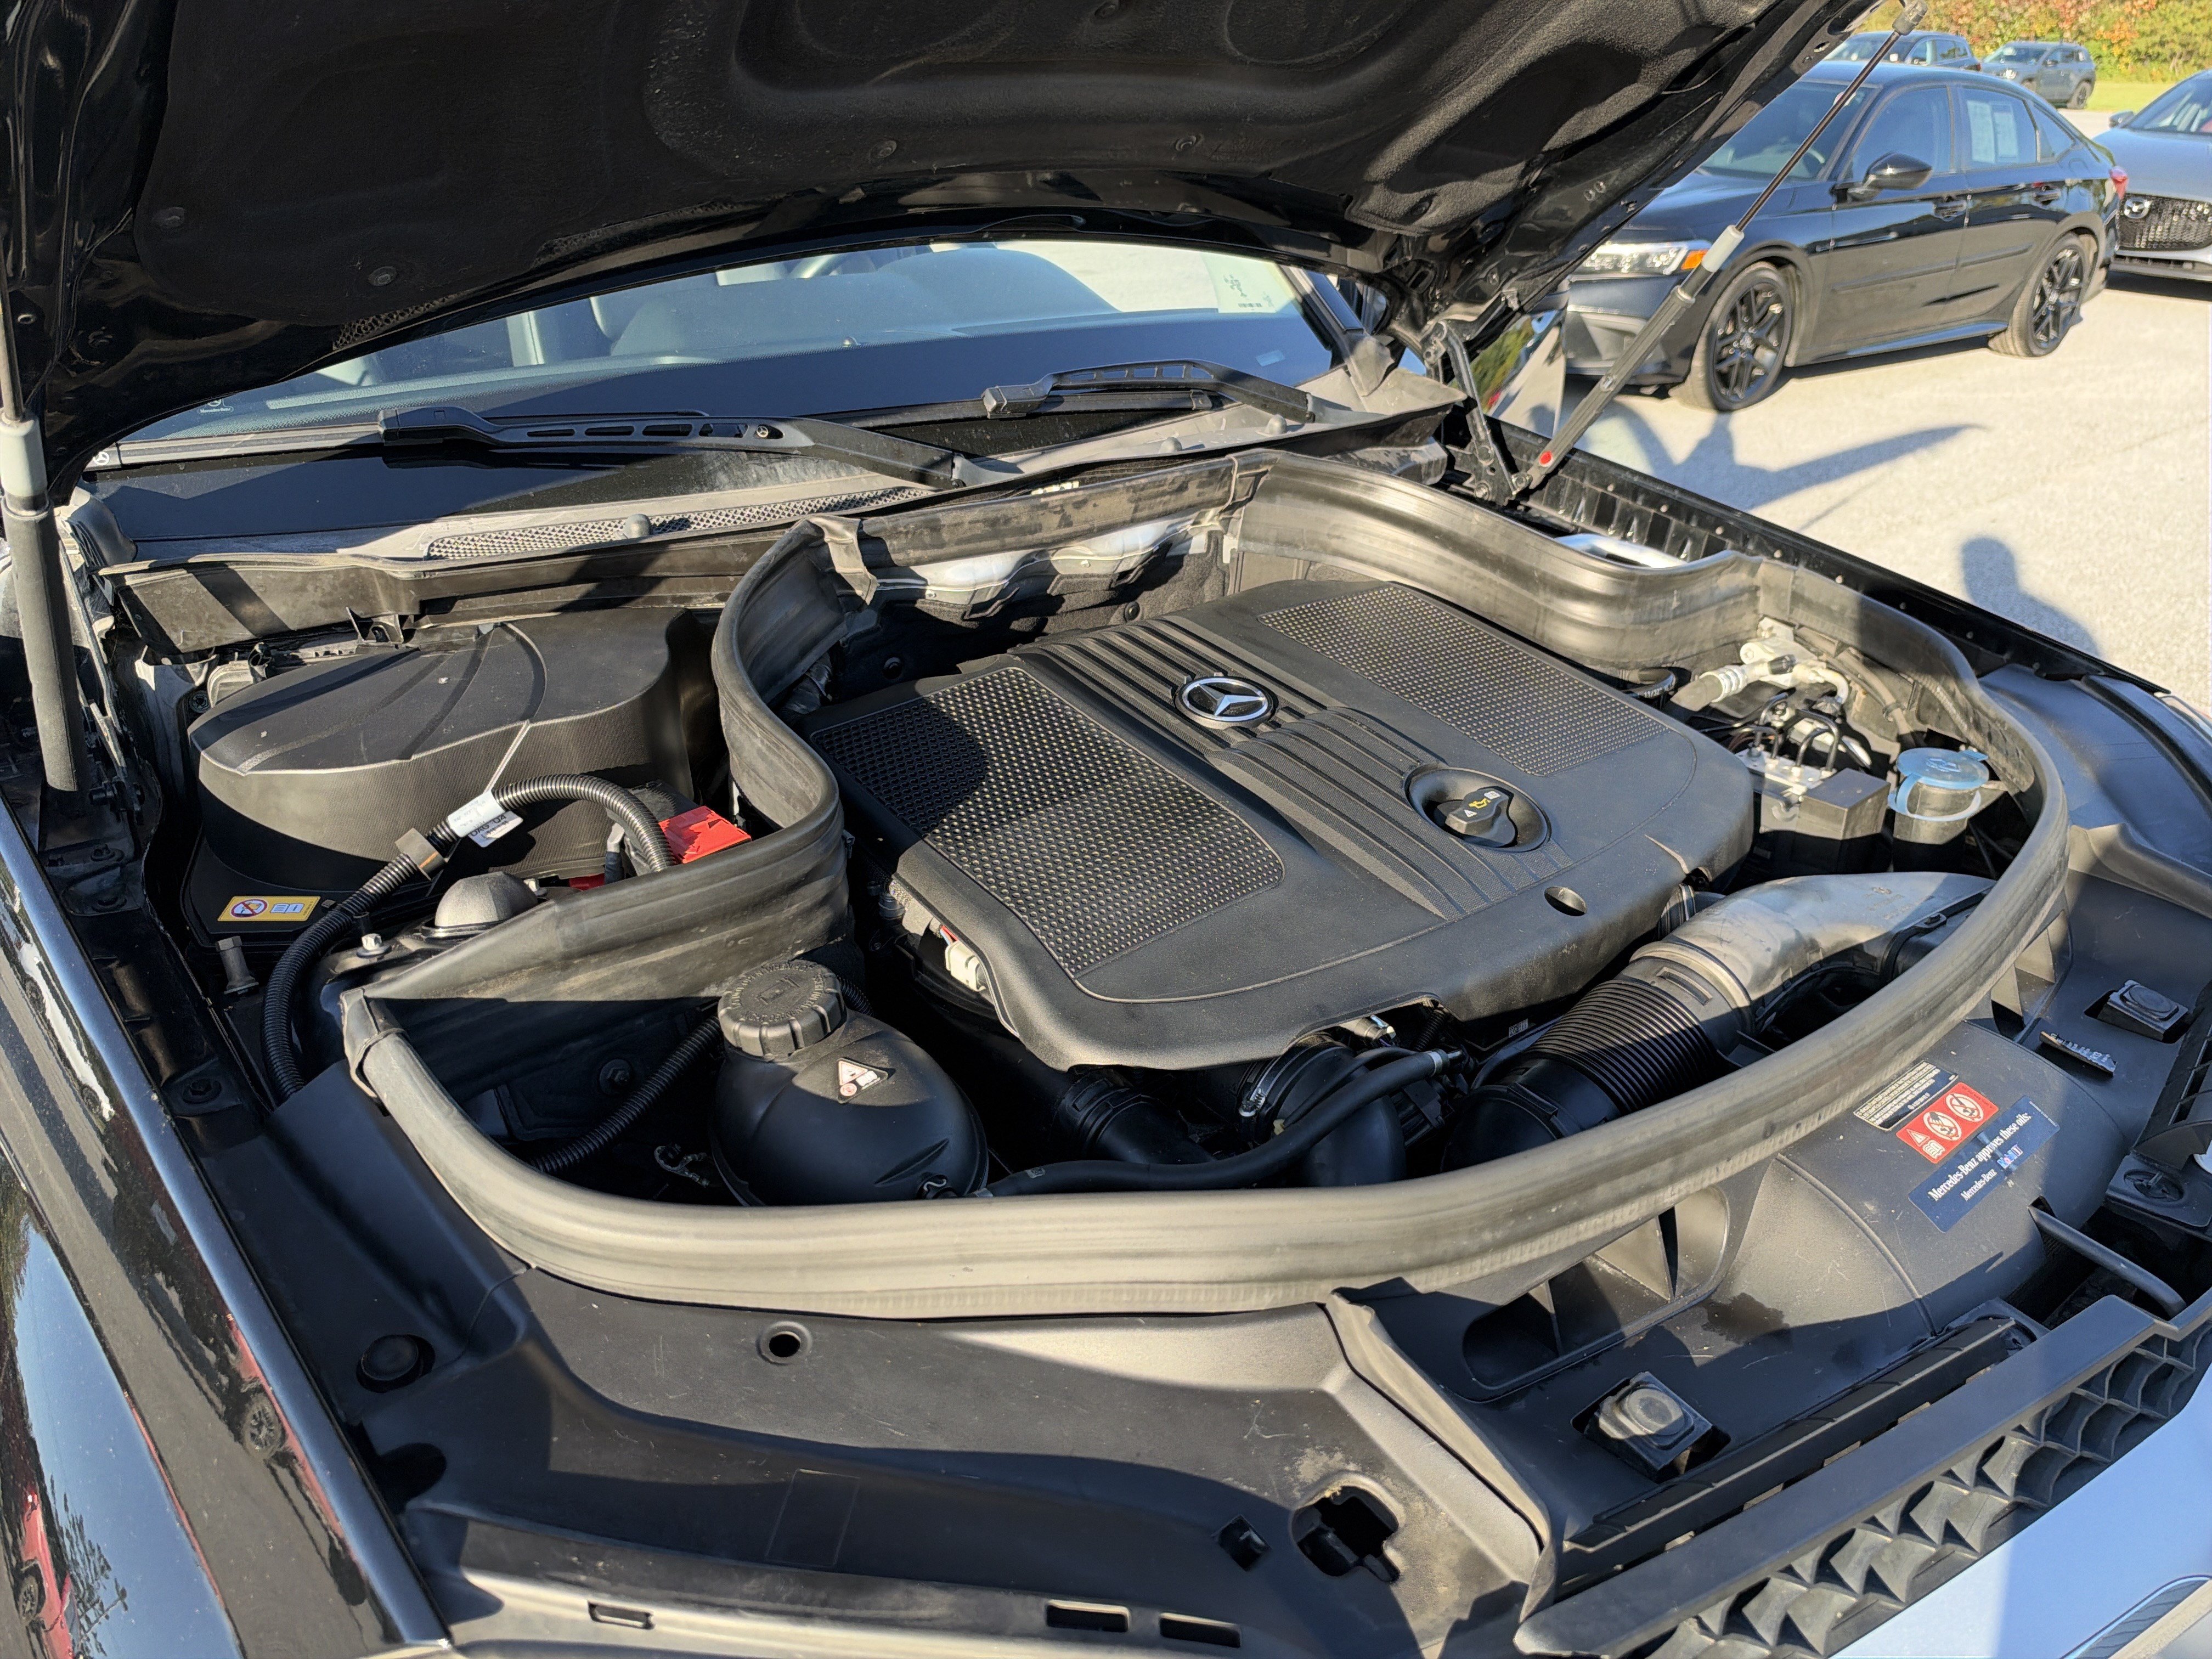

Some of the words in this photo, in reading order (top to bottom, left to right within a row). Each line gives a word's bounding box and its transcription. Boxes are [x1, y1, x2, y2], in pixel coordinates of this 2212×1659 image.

[1928, 1158, 1979, 1201] Mercedes-Benz
[1975, 1135, 2004, 1161] approves
[1999, 1122, 2019, 1140] these
[2016, 1112, 2032, 1126] oils:
[1960, 1169, 1997, 1201] Mercedes-Benz
